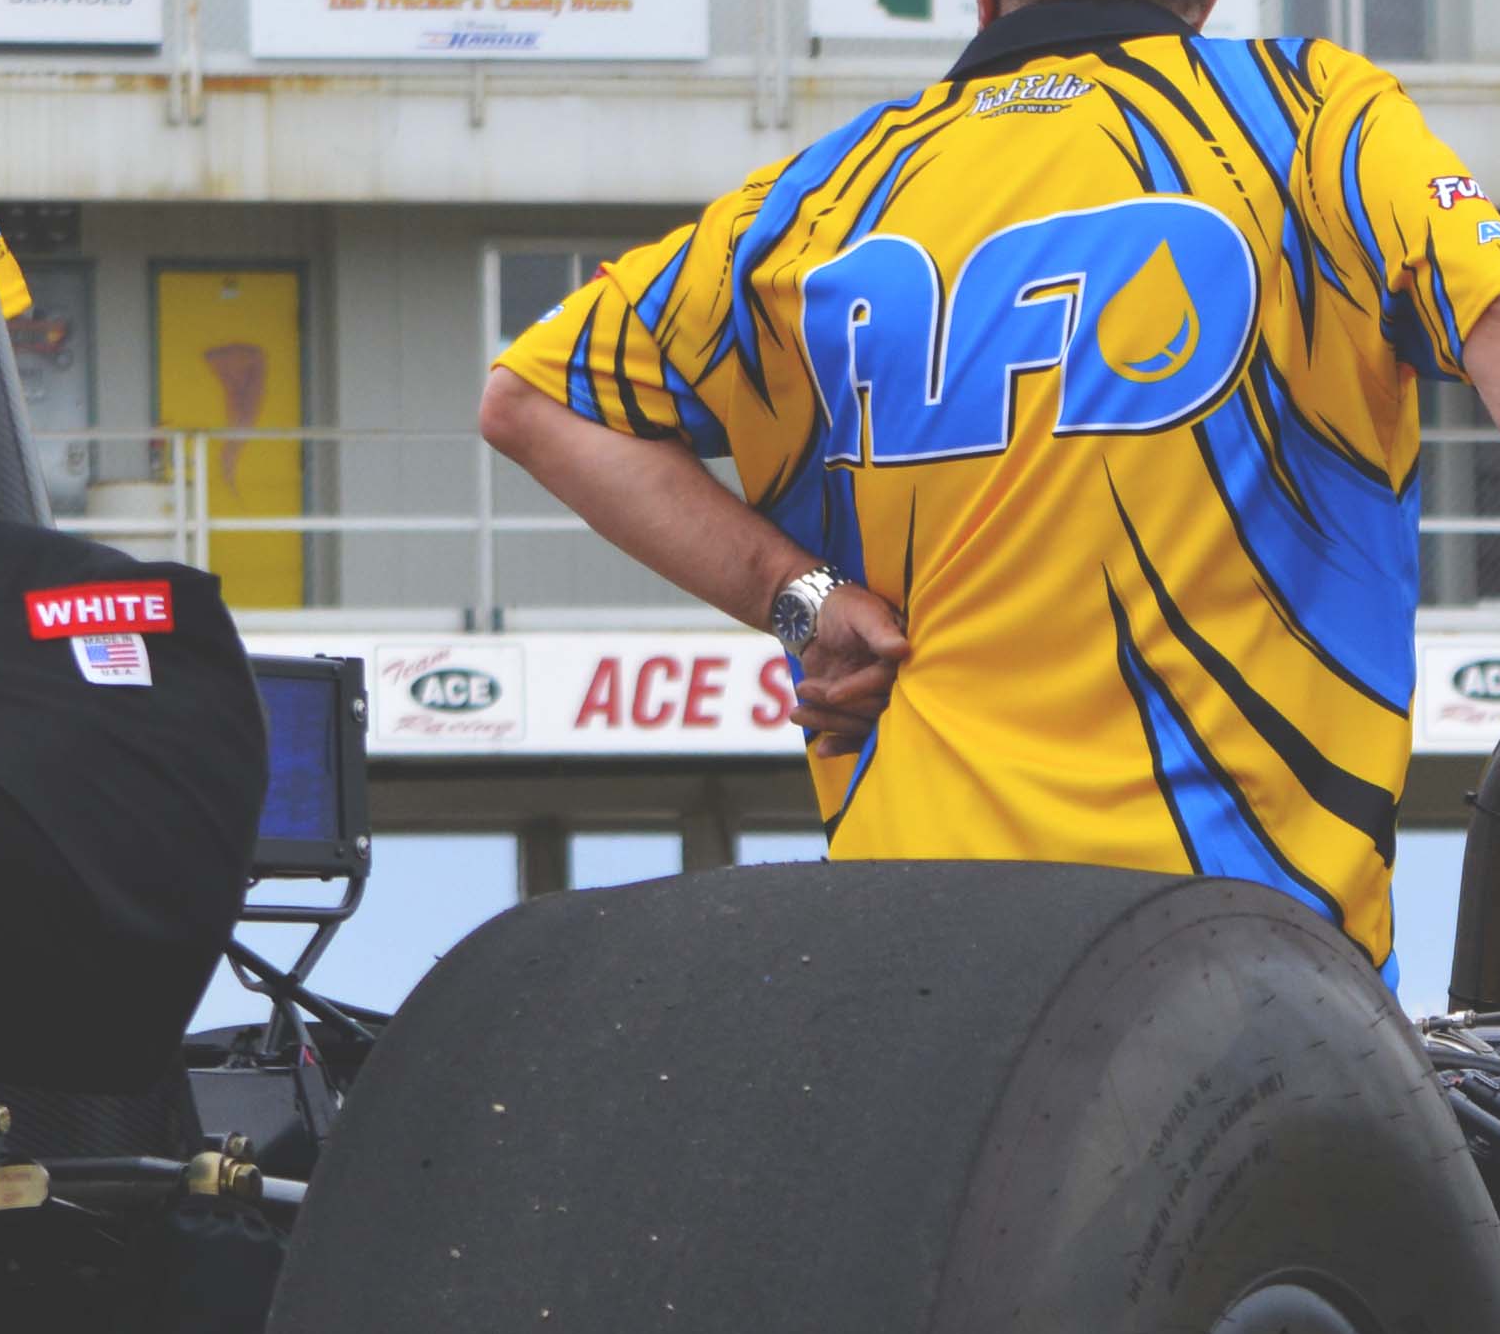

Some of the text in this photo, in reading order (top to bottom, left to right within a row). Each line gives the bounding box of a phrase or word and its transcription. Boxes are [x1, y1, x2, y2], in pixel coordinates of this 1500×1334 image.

[967, 74, 1095, 117] Fast Eddie
[36, 595, 167, 627] WHITE
[421, 674, 491, 706] ACE
[575, 656, 731, 729] ACE
